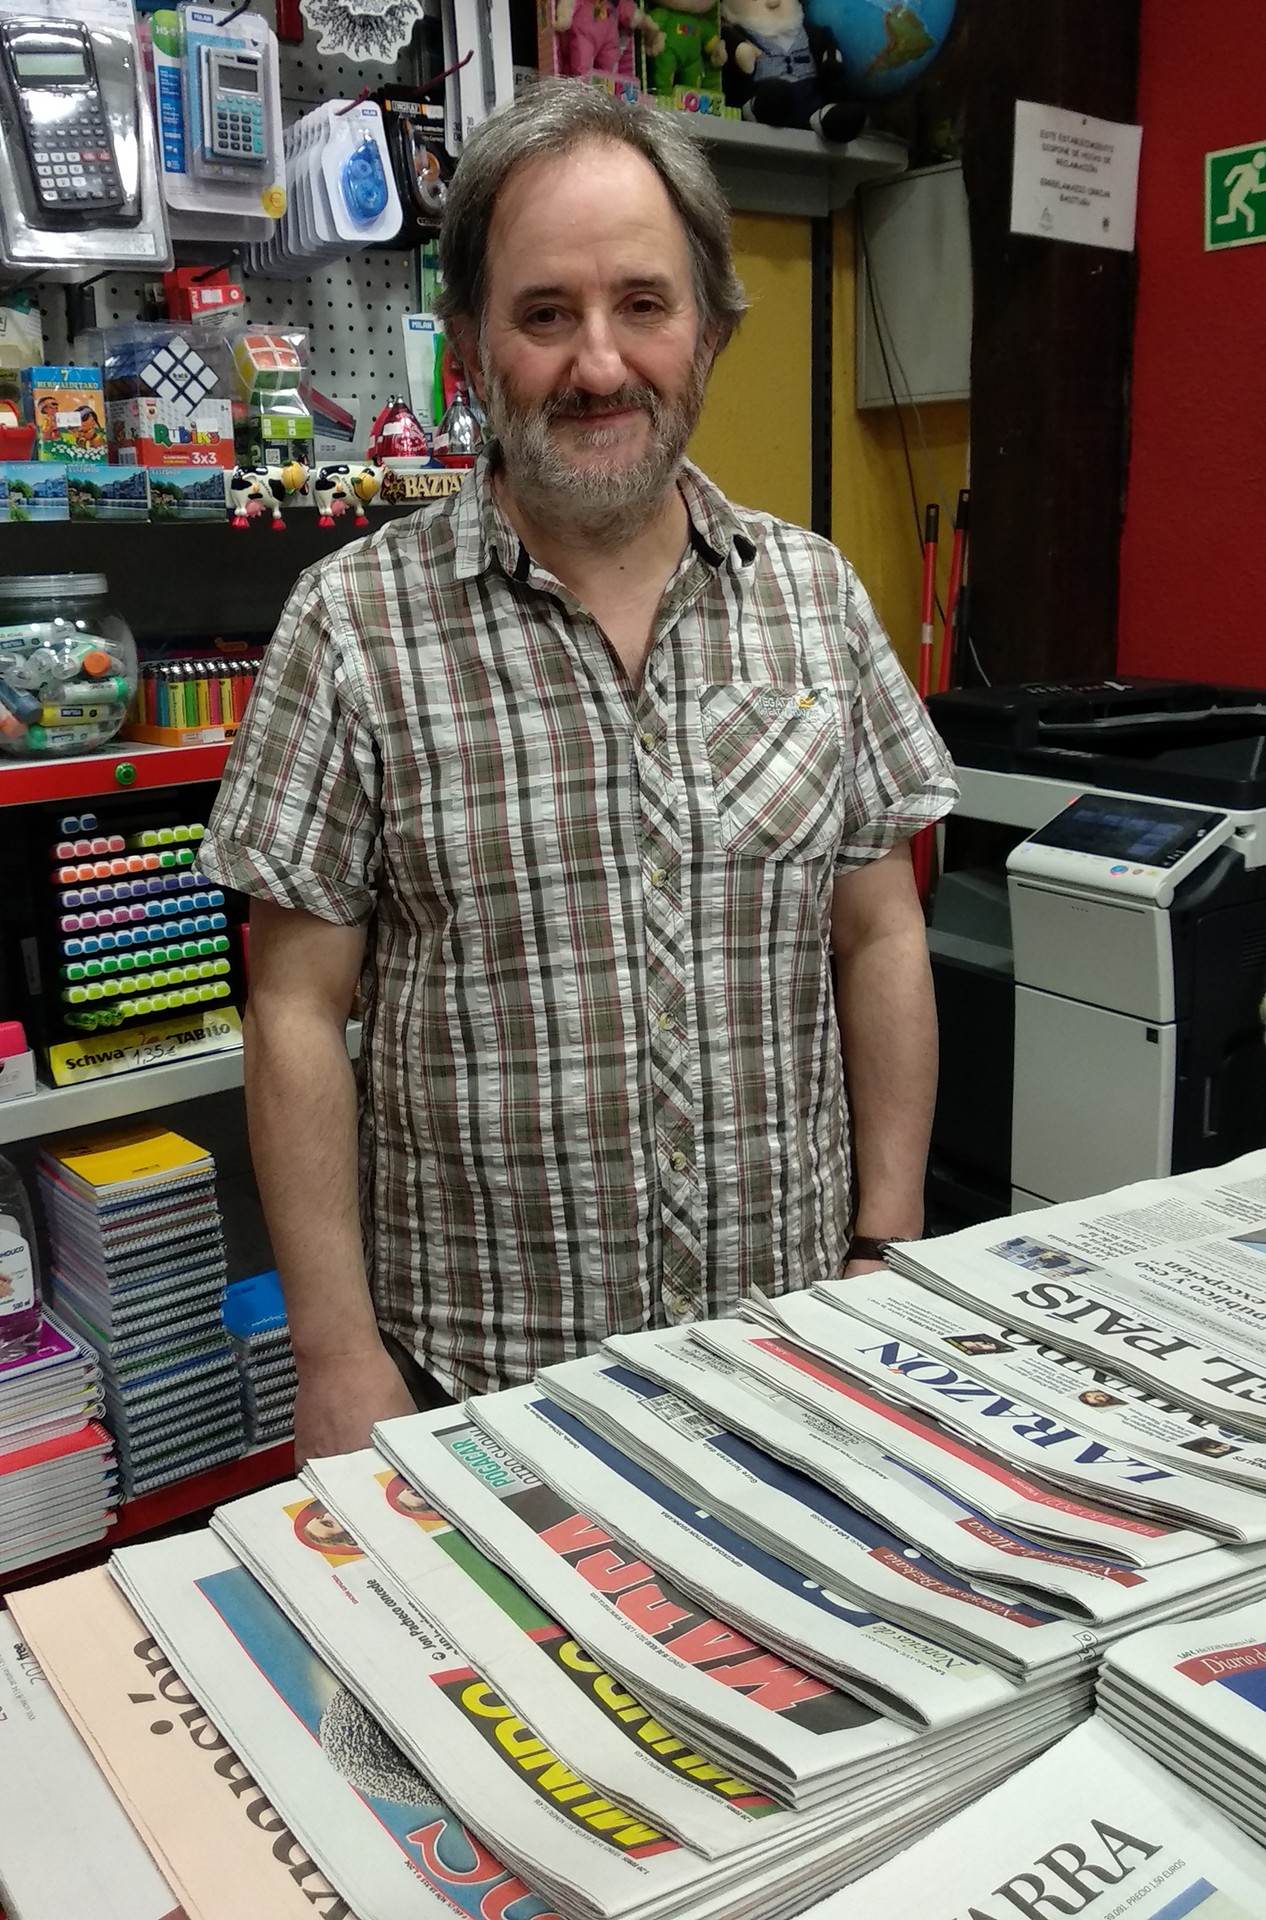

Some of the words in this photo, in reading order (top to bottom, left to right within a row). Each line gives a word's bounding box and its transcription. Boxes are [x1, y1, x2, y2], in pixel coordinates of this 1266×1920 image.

[411, 320, 433, 330] MILAN
[60, 369, 70, 381] 7
[191, 452, 217, 464] 3x3
[65, 1046, 133, 1071] Schwa
[1042, 1232, 1097, 1255] pandemia
[1086, 1237, 1132, 1256] pobreza
[1094, 1235, 1115, 1243] de
[1109, 1240, 1140, 1253] nivel
[1118, 1238, 1150, 1250] Gran
[1091, 1253, 1110, 1261] La
[1130, 1260, 1172, 1277] eso
[1133, 1273, 1214, 1307] CONFINAMIENTO
[1166, 1275, 1194, 1285] y
[1012, 1282, 1202, 1361] PAÍS
[1223, 1312, 1266, 1331] DEROGA
[856, 1341, 1061, 1450] RAZÓN
[442, 1436, 520, 1489] POGACAR
[499, 1457, 541, 1485] OTRO
[714, 1451, 743, 1472] lurraren
[1071, 1441, 1181, 1486] LA
[739, 1470, 759, 1484] Gure
[1038, 1496, 1083, 1513] 2021
[882, 1553, 942, 1587] Bizkaia
[363, 1576, 397, 1609] concede
[540, 1513, 835, 1711] MARCA
[588, 1591, 622, 1622] www.marca.com
[391, 1604, 423, 1640] Pacheco
[868, 1623, 896, 1638] de
[11, 1641, 30, 1661] free
[417, 1633, 437, 1652] Jon
[889, 1634, 966, 1668] Noticias
[1200, 1652, 1257, 1675] Diario
[461, 1682, 663, 1846] MUNDO
[952, 1818, 1163, 1920] RRA
[1127, 1884, 1151, 1906] PRECIO
[1149, 1873, 1165, 1889] 1,50
[1162, 1857, 1185, 1879] EUROS
